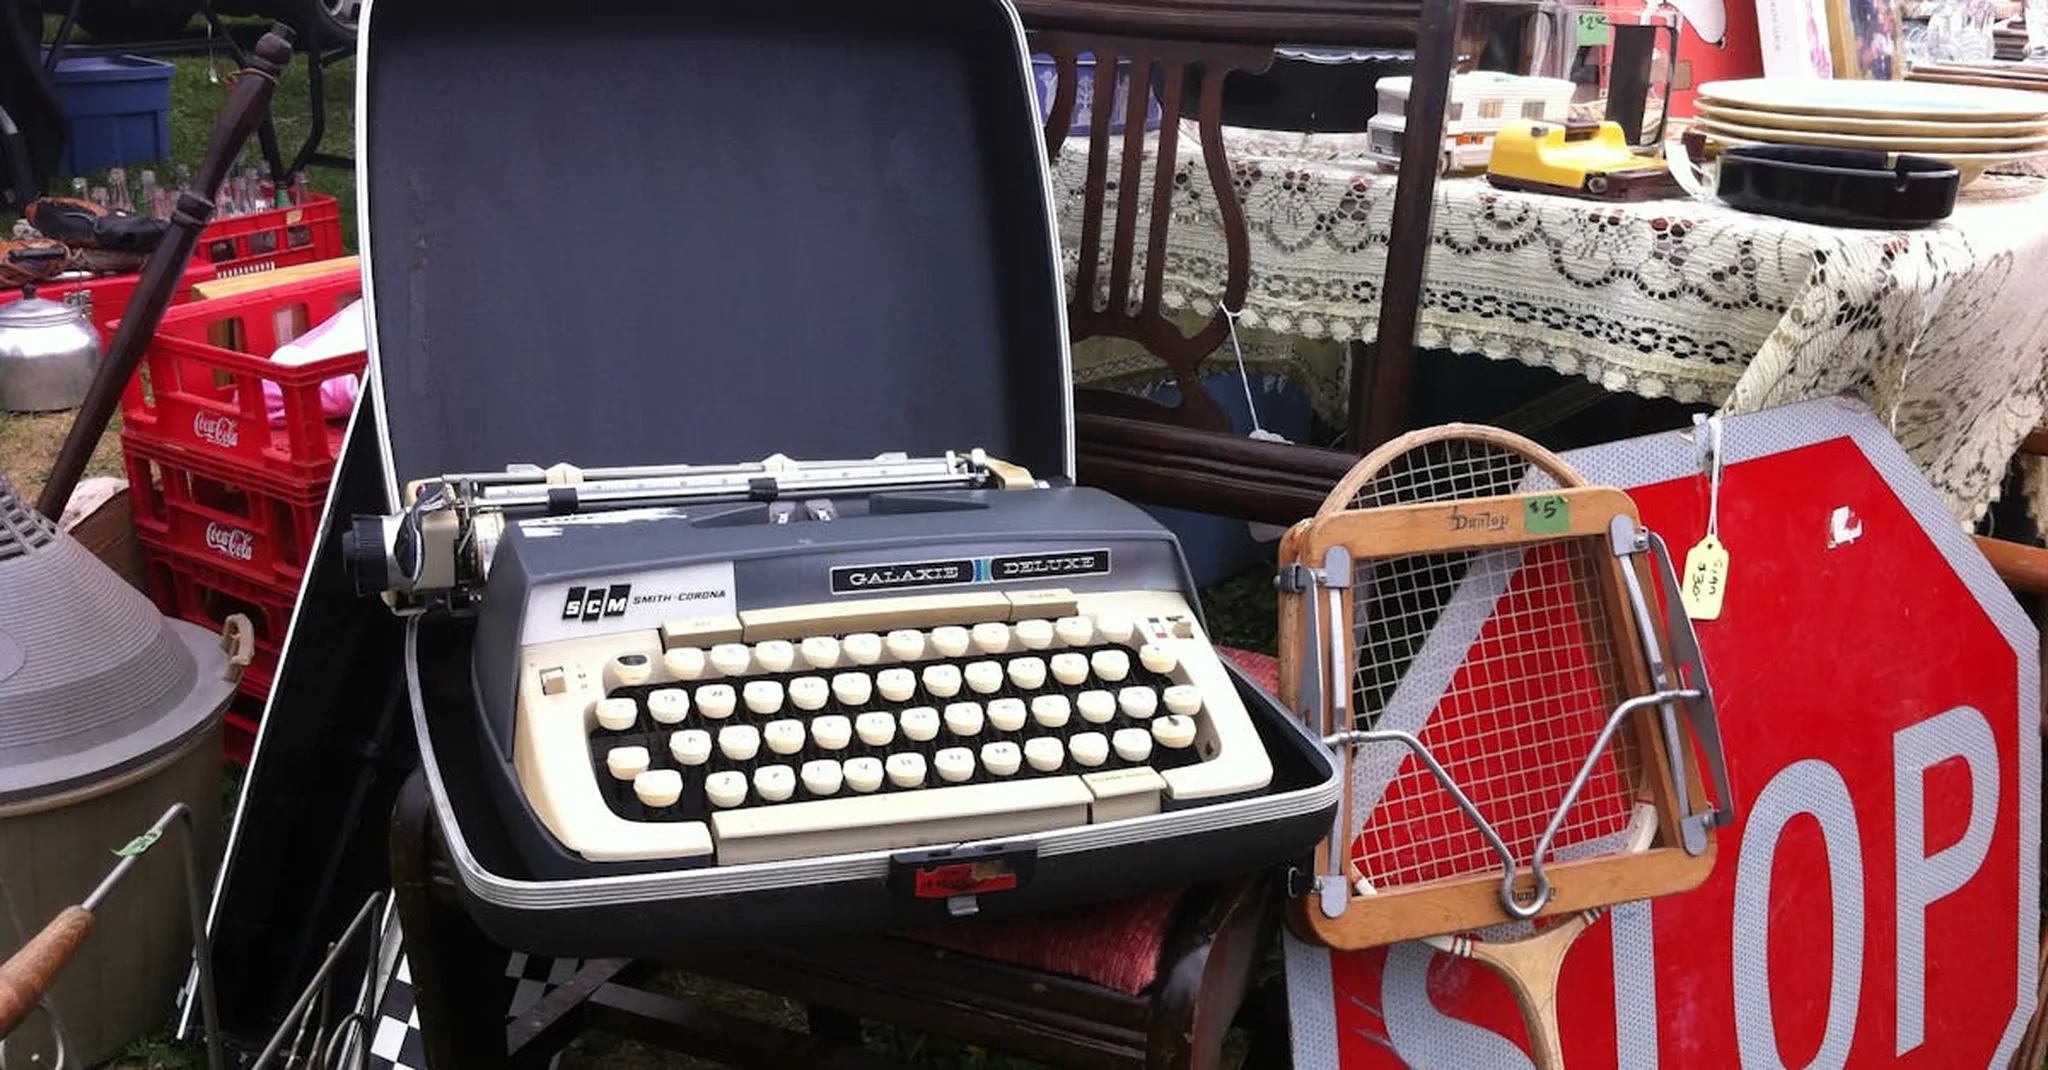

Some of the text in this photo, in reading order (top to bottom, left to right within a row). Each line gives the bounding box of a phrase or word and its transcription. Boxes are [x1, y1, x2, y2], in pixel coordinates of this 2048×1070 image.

[194, 411, 238, 447] Coca-Cola
[1446, 505, 1509, 531] Dunlop
[206, 521, 252, 560] Coca-Cola
[850, 555, 1095, 586] GALAXIE DELUXE
[563, 594, 629, 619] SCM
